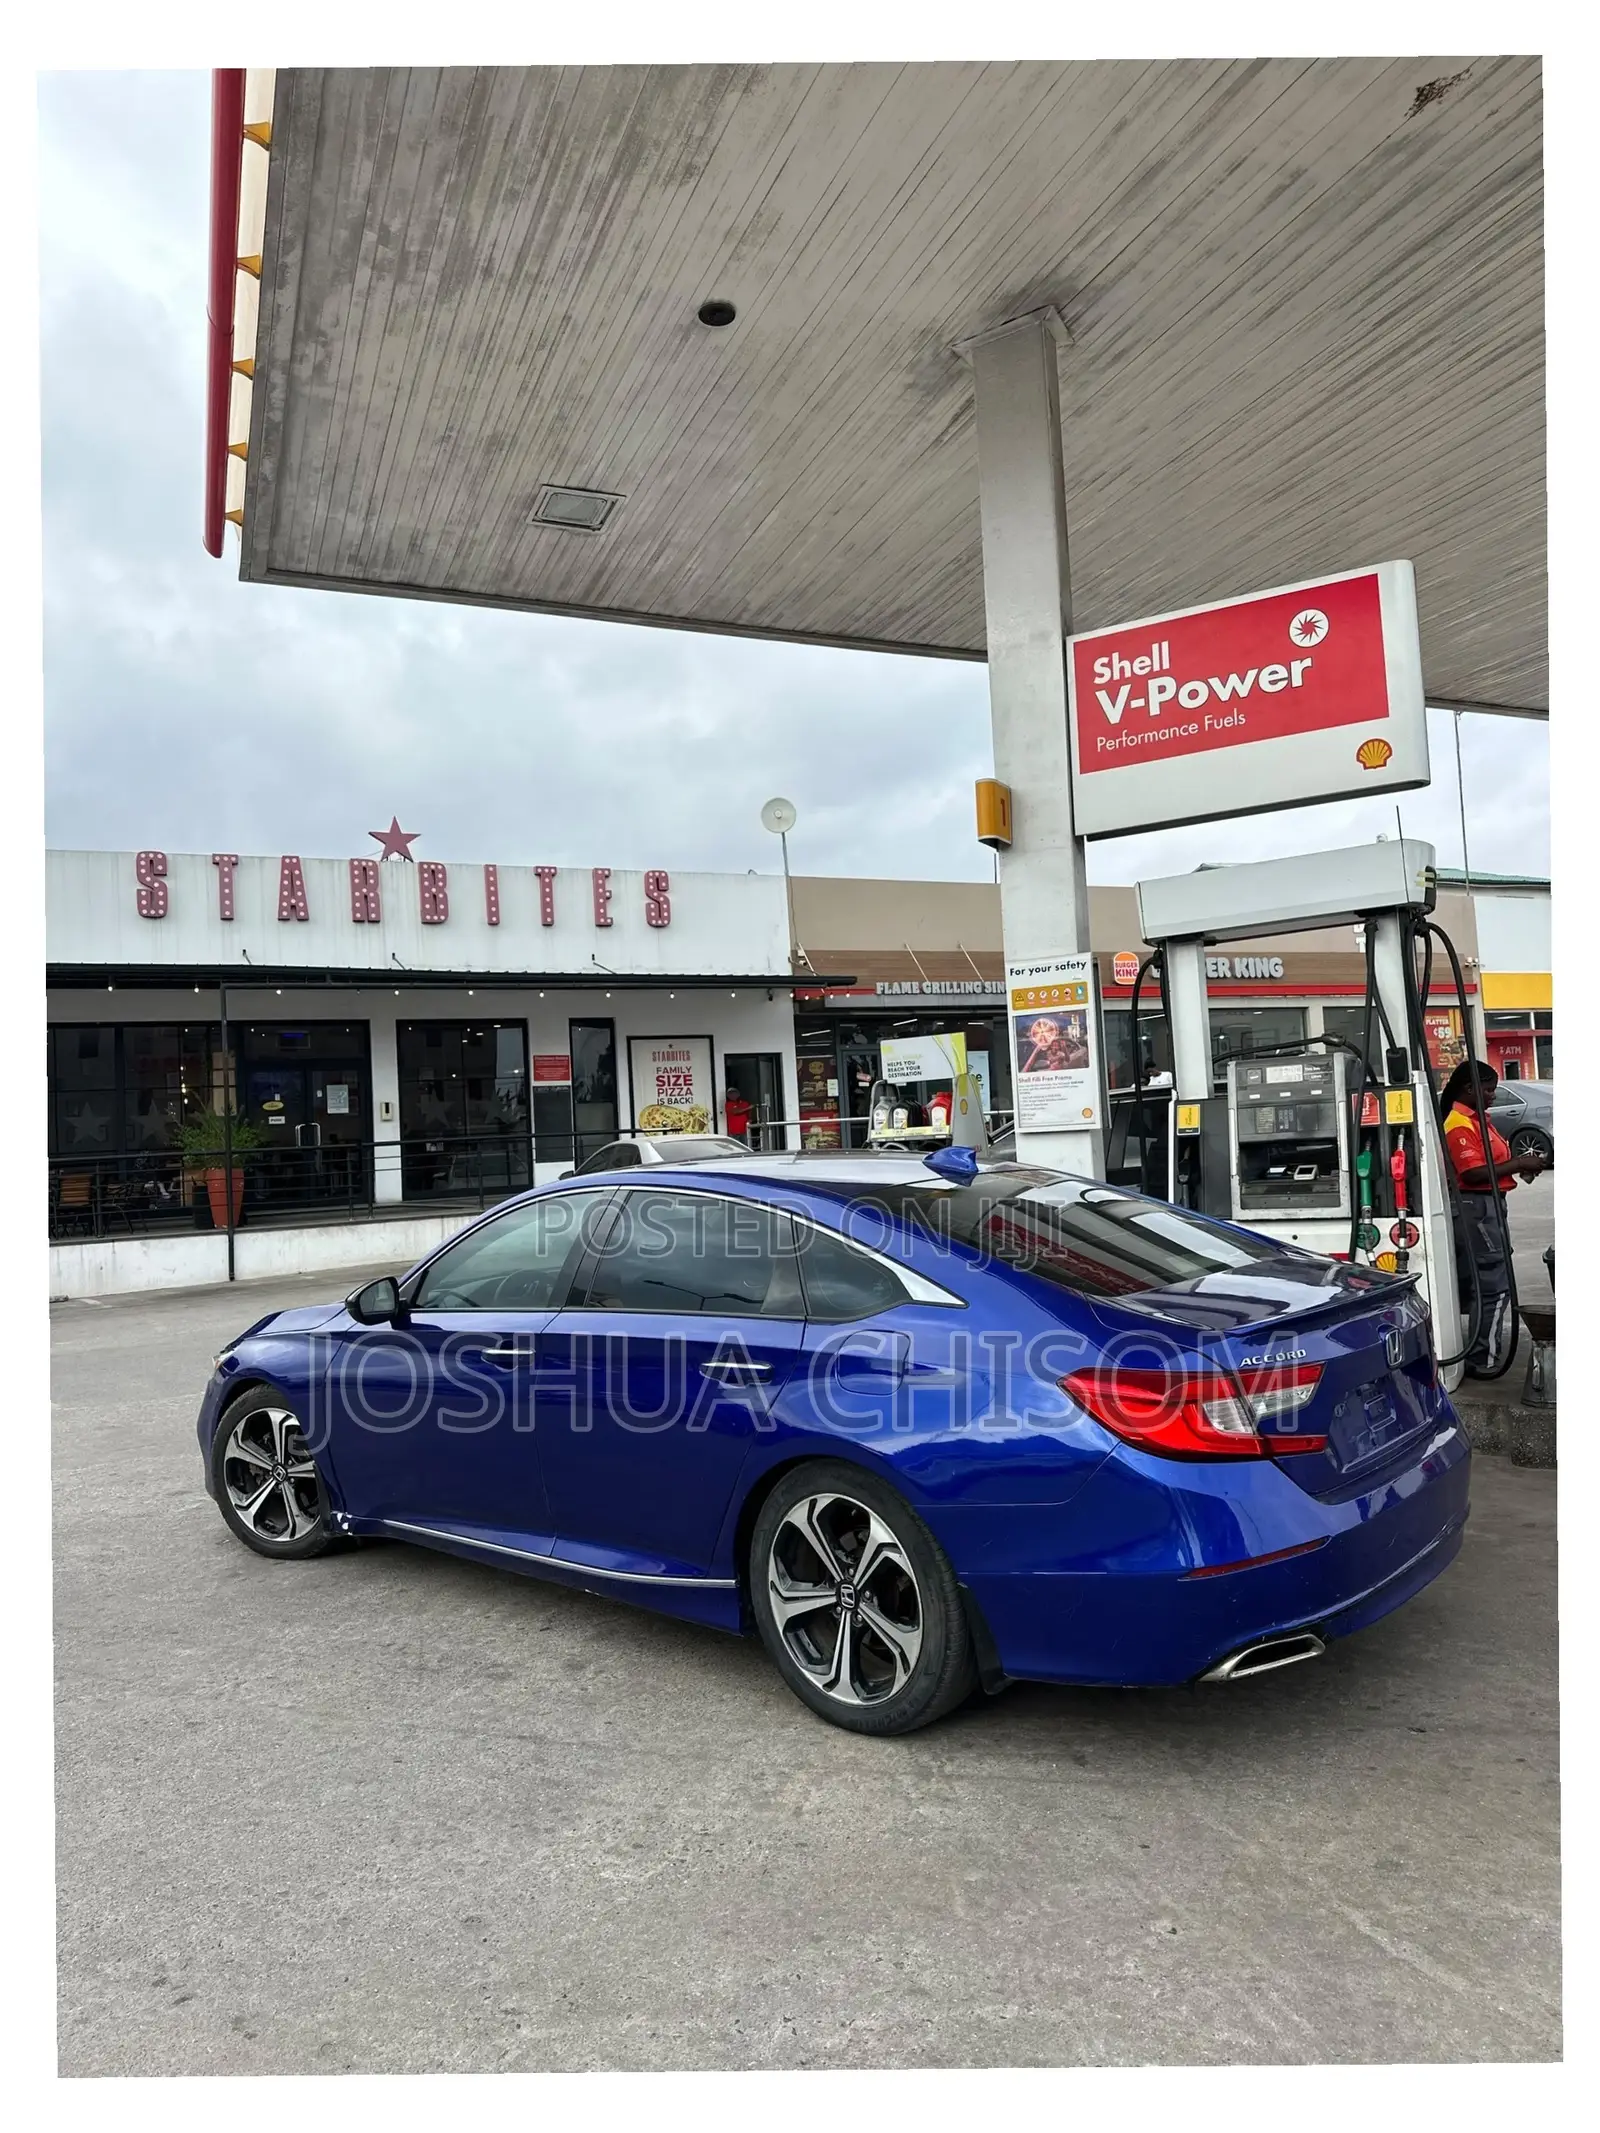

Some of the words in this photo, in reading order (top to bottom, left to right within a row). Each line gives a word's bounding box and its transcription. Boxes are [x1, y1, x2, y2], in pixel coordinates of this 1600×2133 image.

[1093, 640, 1170, 684] Shell
[1095, 656, 1313, 725] V-Power
[1096, 721, 1199, 753] Performance
[1204, 708, 1246, 731] Fuels
[136, 851, 671, 927] STARBITES
[1009, 968, 1026, 976] For
[1028, 965, 1052, 976] your
[1055, 960, 1087, 971] safety
[1115, 968, 1138, 977] KING
[1235, 957, 1284, 978] KING
[876, 981, 920, 995] FLAME
[922, 981, 983, 995] GRILLING
[652, 1050, 691, 1062] STARBITES
[1505, 1046, 1521, 1055] ATM
[656, 1066, 692, 1074] FAMILY
[656, 1074, 693, 1087] SIZE
[657, 1087, 693, 1097] PIZZA
[657, 1097, 665, 1105] IS
[1240, 1349, 1307, 1367] ACCORD
